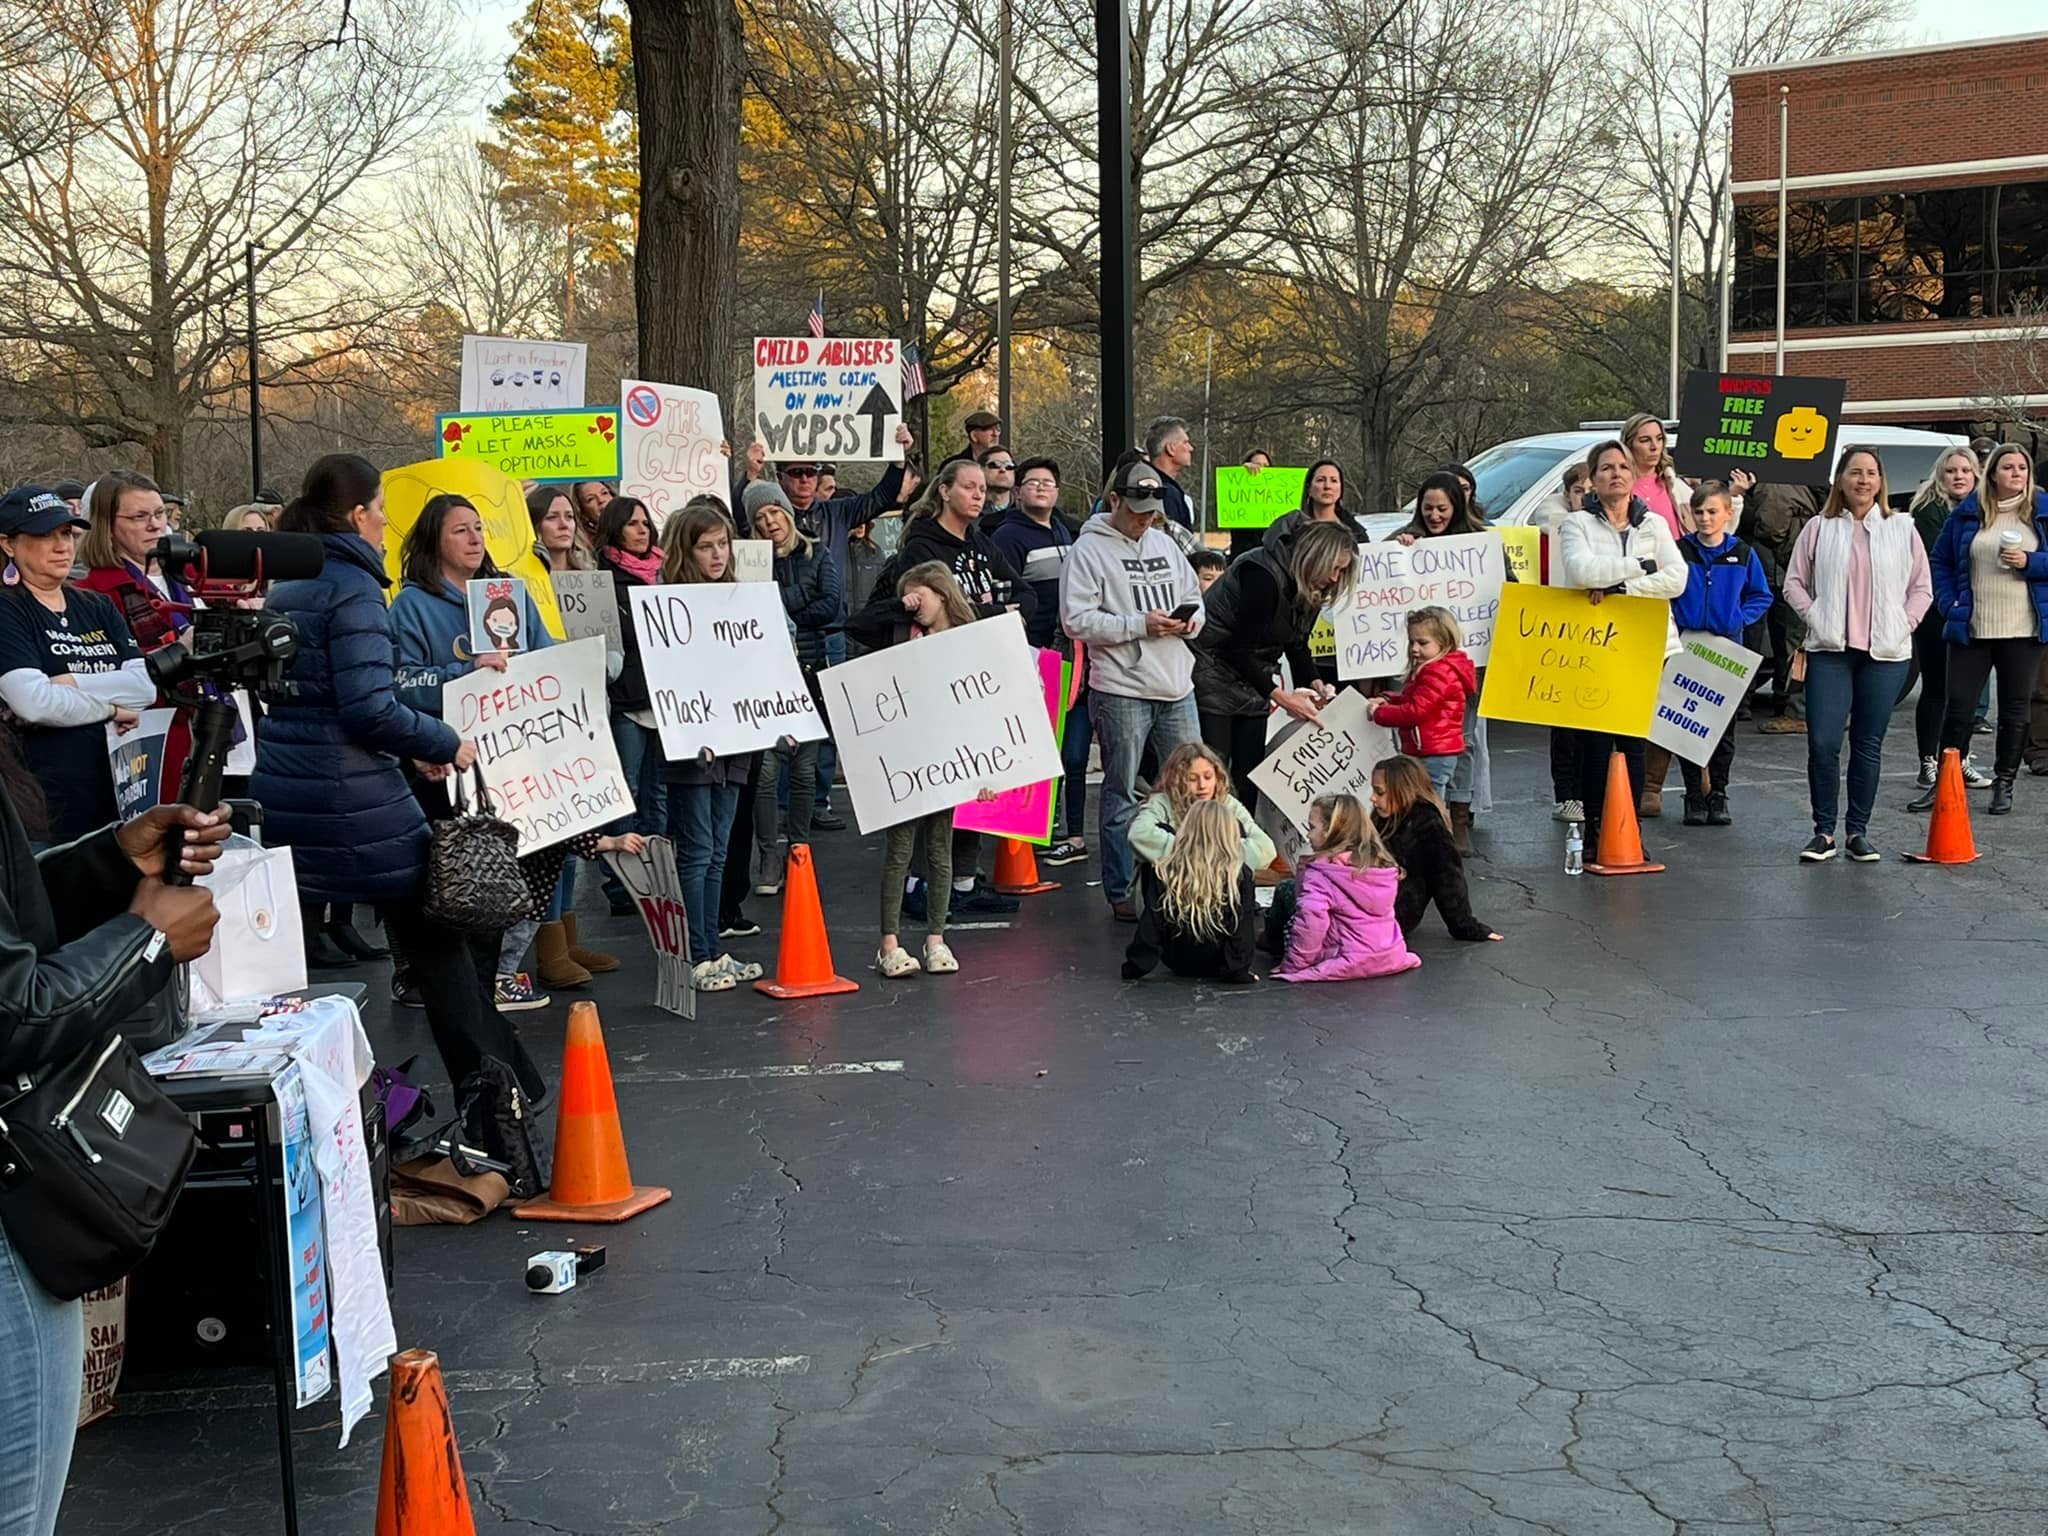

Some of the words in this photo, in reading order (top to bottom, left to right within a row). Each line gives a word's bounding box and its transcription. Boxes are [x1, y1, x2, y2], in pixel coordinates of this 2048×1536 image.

[756, 338, 809, 367] CHILD
[817, 341, 895, 366] ABUSERS
[768, 371, 828, 388] MEETING
[839, 371, 877, 386] GOING
[785, 392, 806, 410] ON
[1722, 396, 1765, 415] FREE
[492, 416, 553, 432] PLEASE
[664, 398, 702, 435] THE
[1720, 418, 1754, 436] THE
[477, 438, 512, 453] LET
[523, 433, 577, 451] MASKS
[758, 411, 860, 456] WCPSS
[1703, 437, 1769, 459] SMILES
[500, 454, 588, 472] OPTIONAL
[1357, 551, 1405, 584] AKE
[1411, 544, 1488, 577] COUNTY
[557, 574, 584, 589] KIDS
[592, 573, 608, 589] BE
[1356, 586, 1415, 610] BOARD
[1418, 582, 1441, 600] OF
[1447, 579, 1475, 599] ED
[557, 593, 587, 613] IDS
[1352, 613, 1370, 635] IS
[1449, 599, 1500, 623] SLEEP
[641, 595, 692, 648] NO
[713, 618, 764, 648] more
[67, 660, 92, 673] with
[94, 660, 116, 672] the
[1346, 638, 1398, 667] MASKS
[1541, 650, 1595, 672] OUR
[1686, 641, 1750, 680] #UNMASKME
[460, 674, 561, 734] DEFEND
[840, 675, 910, 737] Let
[949, 670, 1001, 705] me
[1672, 672, 1726, 708] ENOUGH
[655, 689, 719, 727] Mask
[732, 690, 814, 730] mandate
[1682, 697, 1700, 713] IS
[1656, 705, 1710, 739] ENOUGH
[130, 753, 148, 775] NOT
[1273, 758, 1296, 787] I
[1292, 727, 1334, 767] MISS
[511, 804, 573, 848] School
[570, 775, 625, 821] Board
[638, 896, 691, 962] NOT
[90, 1323, 118, 1348] SAN
